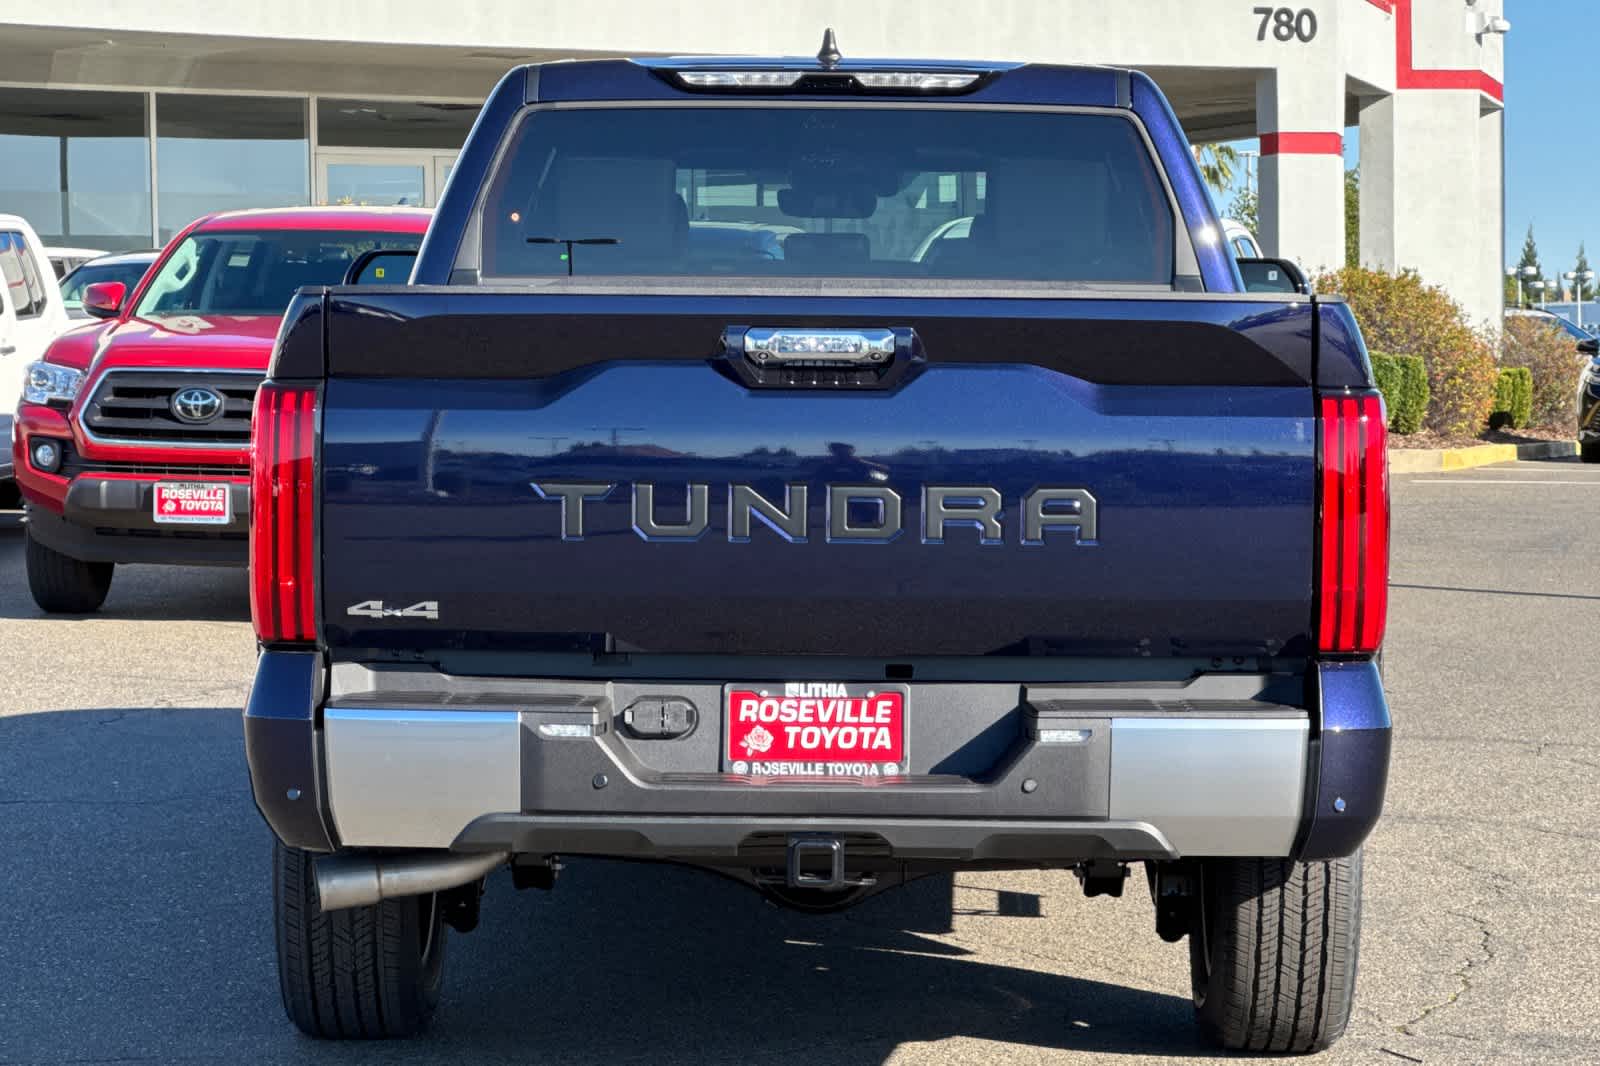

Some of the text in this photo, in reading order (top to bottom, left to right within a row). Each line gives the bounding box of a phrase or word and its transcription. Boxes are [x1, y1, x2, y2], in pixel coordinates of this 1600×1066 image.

[1253, 7, 1317, 43] 780
[161, 488, 224, 500] ROSEVILLE
[179, 500, 224, 511] TOYOTA
[530, 482, 1098, 545] TUNDRA
[800, 683, 848, 698] LITHIA
[739, 700, 893, 723] ROSEVILLE
[784, 726, 892, 750] TOYOTA
